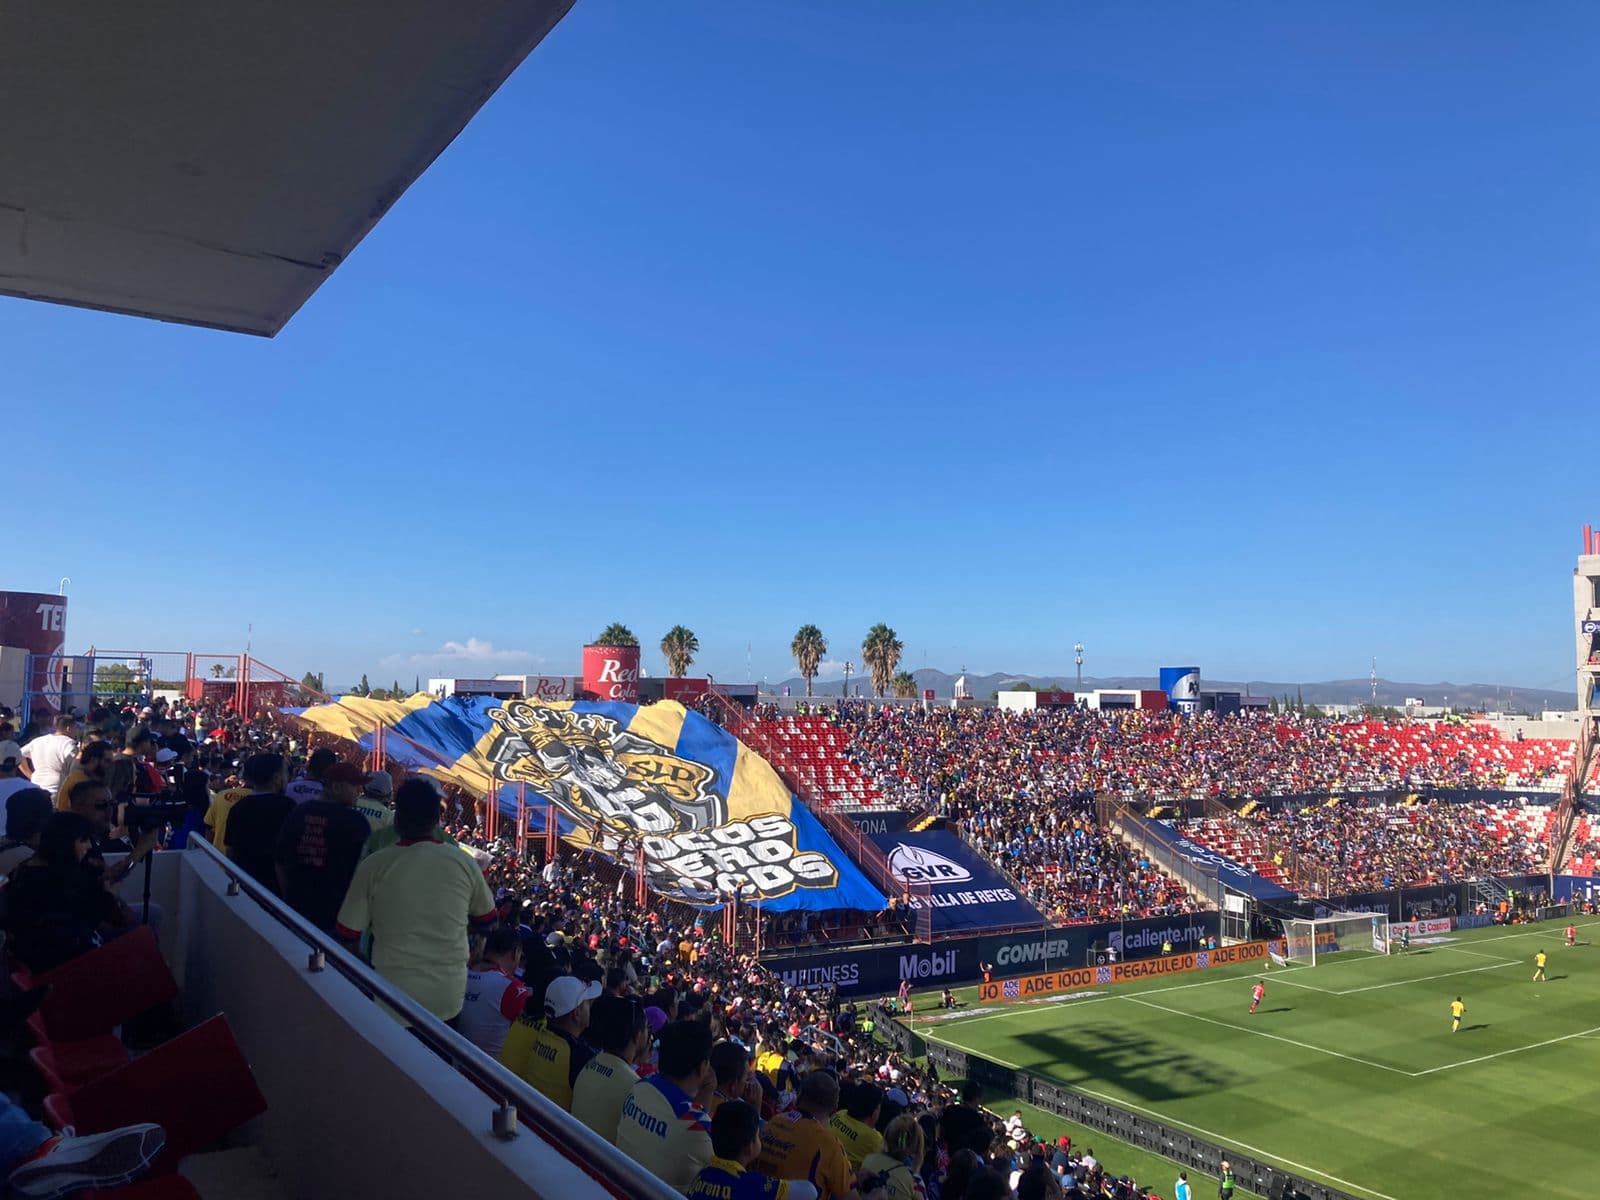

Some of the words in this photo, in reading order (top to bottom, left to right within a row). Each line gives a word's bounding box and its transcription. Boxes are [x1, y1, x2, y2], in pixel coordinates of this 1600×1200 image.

[597, 659, 639, 683] Red
[535, 678, 566, 695] Red
[609, 683, 637, 698] Cola
[854, 818, 888, 836] ZONA
[901, 862, 955, 880] GVR
[956, 891, 979, 905] DE
[974, 887, 1018, 904] REYES
[1124, 924, 1206, 950] caliente.mx
[996, 938, 1069, 966] GONHER
[1213, 949, 1235, 964] ADE
[1239, 944, 1263, 958] 1000
[899, 950, 956, 979] Mobil
[1115, 955, 1193, 980] PEGAZULEJO
[1025, 976, 1053, 993] ADE
[1058, 970, 1091, 987] 1000
[622, 1092, 668, 1138] Corona
[829, 1115, 859, 1142] Corona
